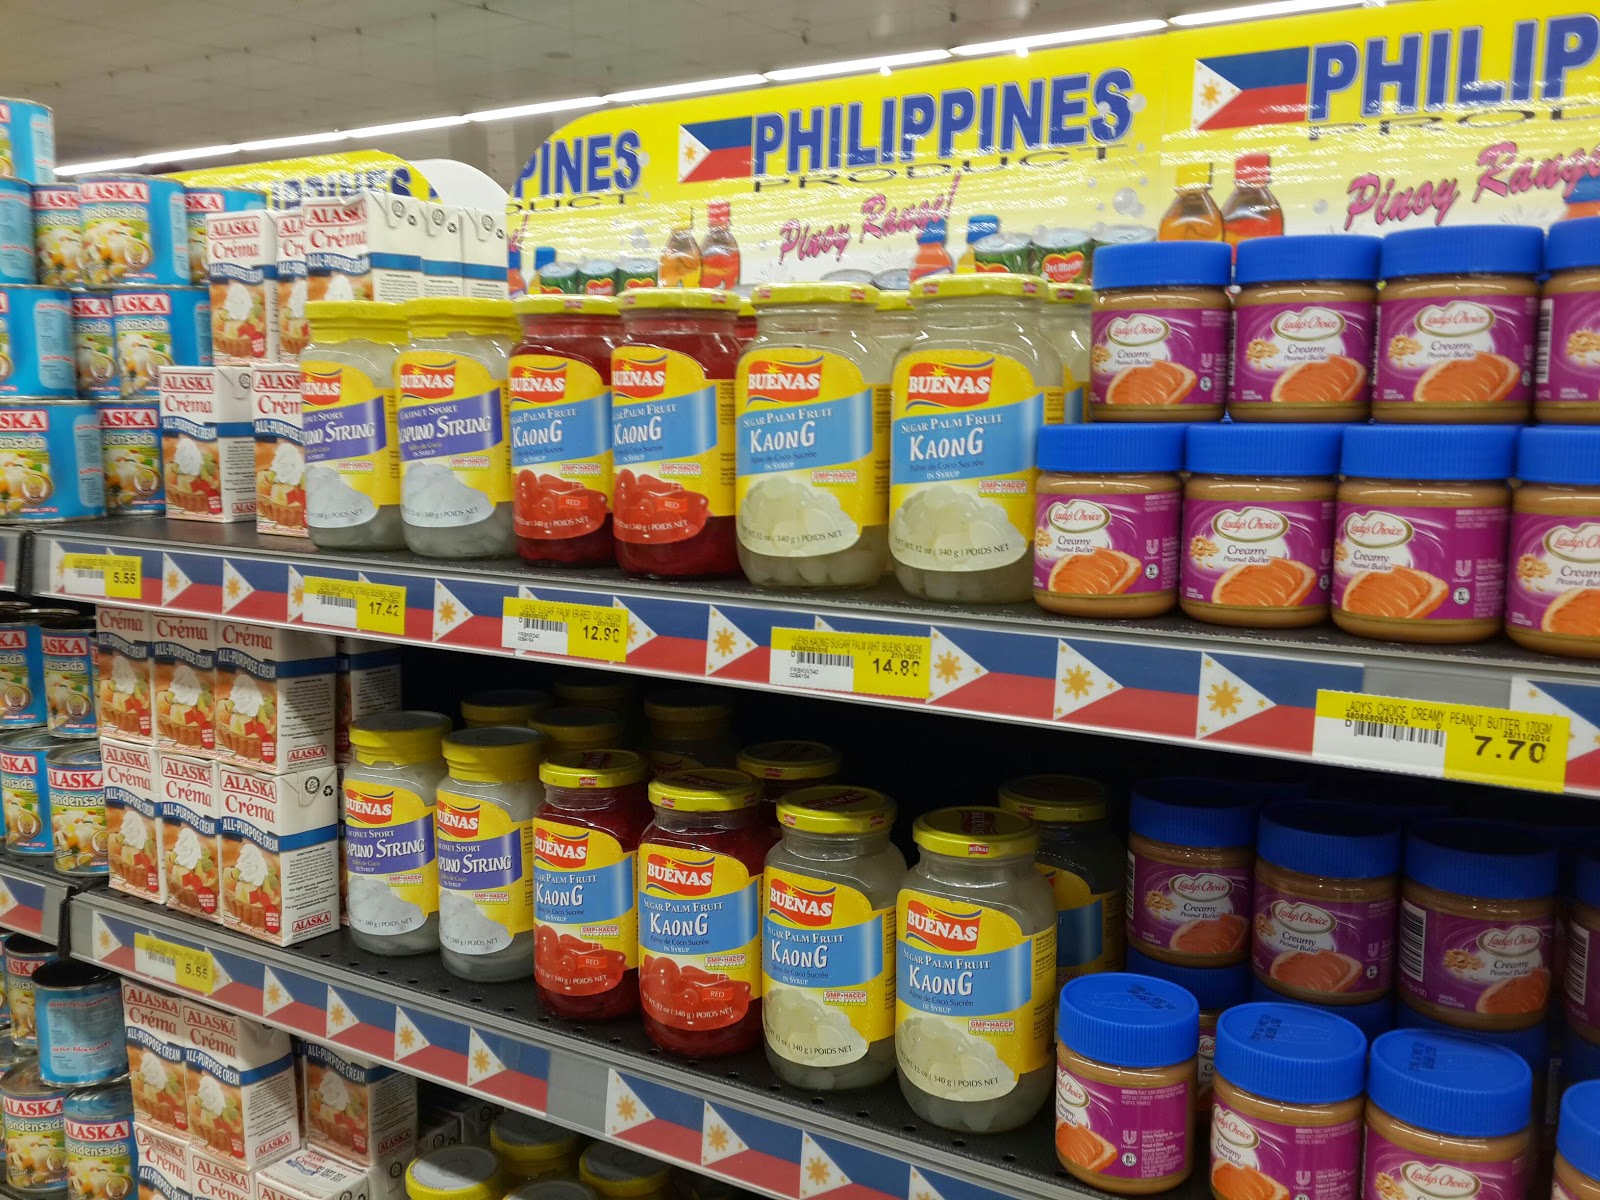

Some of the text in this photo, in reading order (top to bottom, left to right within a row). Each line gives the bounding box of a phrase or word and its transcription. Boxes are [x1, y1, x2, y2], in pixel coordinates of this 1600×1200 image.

[753, 67, 1134, 177] PHILIPPINES
[754, 143, 1129, 192] PRODUCT
[1344, 172, 1460, 230] Pinoy
[308, 203, 367, 222] ALASKA
[211, 220, 259, 236] ALASKA
[778, 217, 850, 265] Pinoy
[163, 376, 213, 391] ALASKA
[510, 377, 565, 392] BUENAS
[747, 372, 820, 389] BUENAS
[908, 376, 991, 394] BUENAS
[165, 396, 212, 414] Créma
[428, 405, 458, 415] SPORT
[547, 408, 577, 419] FRUIT
[646, 404, 678, 415] FRUIT
[766, 406, 833, 424] PALM FRUIT
[930, 417, 962, 431] PALM
[965, 413, 1003, 426] FRUIT
[325, 421, 375, 442] STRING
[437, 415, 491, 437] STRING
[664, 501, 679, 509] RED
[1073, 508, 1102, 521] Choice
[1222, 516, 1280, 530] Lady's Choice
[1371, 522, 1403, 536] Choice
[1058, 536, 1090, 546] Creamy
[1227, 545, 1267, 555] Creamy
[1354, 550, 1389, 562] Creamy
[113, 572, 136, 584] 5.55
[100, 612, 144, 632] Créma
[156, 620, 209, 641] Créma
[222, 626, 273, 650] Créma
[1377, 703, 1407, 719] CHOICE
[1411, 708, 1445, 721] CREAMY
[1450, 712, 1483, 727] PEANUT
[1487, 716, 1520, 732] BUTTER
[1503, 731, 1551, 742] 25/11/2014
[105, 746, 150, 770] ALASKA
[289, 747, 325, 761] ALASKA
[1474, 735, 1546, 763] 7.70
[107, 766, 151, 791] Créma
[165, 762, 211, 784] ALASKA
[166, 781, 212, 807] Créma
[224, 776, 274, 800] ALASKA
[106, 787, 154, 816] ALL-PURPOSE CREAM
[225, 795, 275, 824] Créma
[163, 804, 215, 834] ALL-PURPOSE CREAM
[223, 819, 279, 851] ALL-PURPOSE CREAM
[368, 829, 394, 838] SPORT
[376, 838, 425, 858] STRING
[456, 844, 481, 852] SPORT
[535, 836, 587, 860] BUENAS
[463, 855, 511, 874] STRING
[546, 874, 598, 884] PALM FRUIT
[648, 863, 712, 887] BUENAS
[1178, 880, 1227, 892] Lady's Choice
[665, 902, 690, 913] PALM
[693, 902, 724, 912] FRUIT
[770, 886, 833, 917] BUENAS
[1183, 902, 1217, 914] Creamy
[294, 913, 330, 932] ALASKA
[907, 908, 978, 942] BUENAS
[1278, 907, 1329, 926] Lady's Choice
[785, 932, 845, 944] PALM FRUIT
[1282, 931, 1316, 947] Creamy
[585, 958, 599, 966] RED
[925, 956, 991, 970] PALM FRUIT
[1494, 960, 1529, 971] Creamy
[572, 976, 592, 984] POIDS
[790, 977, 809, 985] SYRUP
[127, 986, 179, 1014] ALASKA
[710, 990, 725, 998] RED
[932, 997, 948, 1005] Coco
[720, 1007, 733, 1015] NET
[931, 1005, 952, 1013] SYRUP
[129, 1008, 177, 1036] Créma
[187, 1011, 236, 1036] ALASKA
[990, 1021, 1014, 1029] HACCP
[127, 1029, 181, 1061] ALL-PURPOSE CREAM
[189, 1028, 236, 1059] Créma
[838, 1045, 852, 1054] NET
[186, 1050, 240, 1085] ALL-PURPOSE CREAM
[984, 1077, 999, 1086] NET
[1229, 1120, 1251, 1140] Choice
[257, 1133, 291, 1156] ALASKA
[146, 1148, 186, 1182] Créma
[195, 1158, 248, 1190] ALASKA
[1410, 1170, 1472, 1189] Lady's Choice
